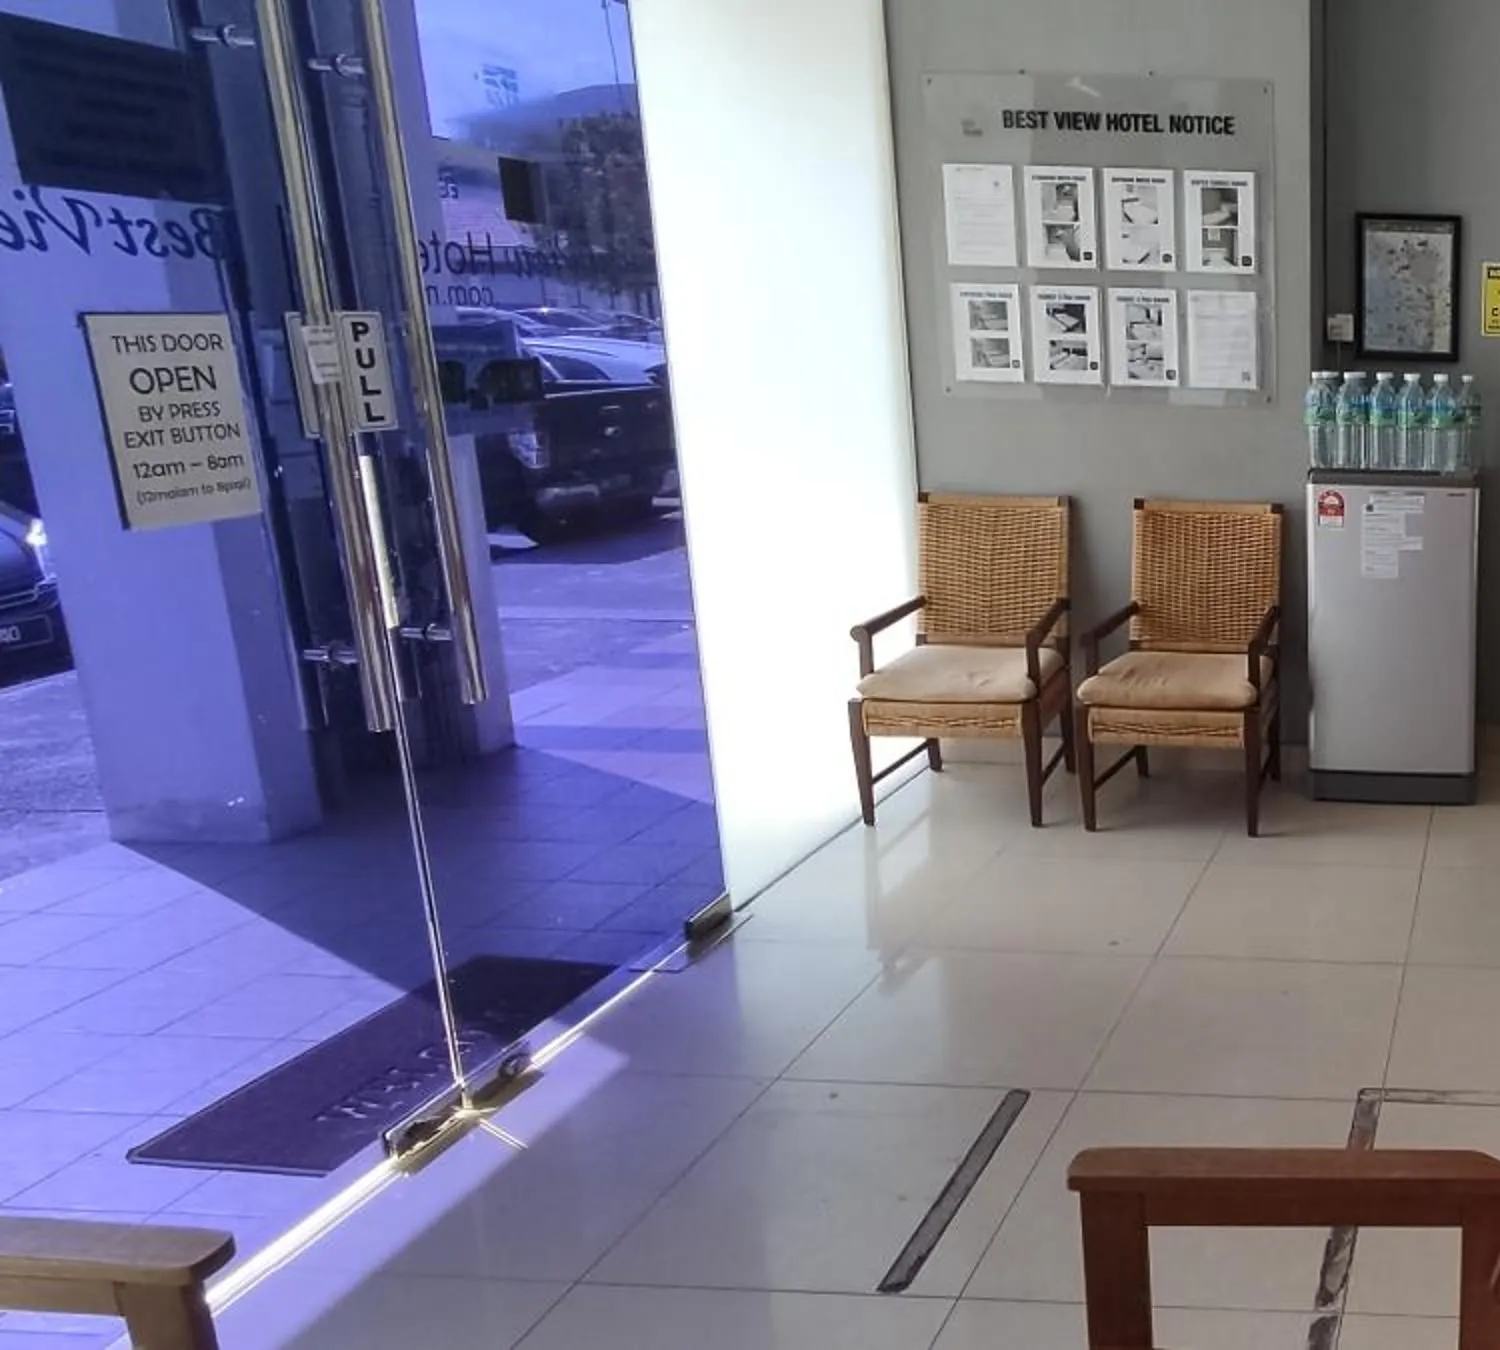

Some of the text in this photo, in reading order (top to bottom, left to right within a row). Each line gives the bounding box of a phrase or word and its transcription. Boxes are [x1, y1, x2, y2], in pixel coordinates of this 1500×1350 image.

[1002, 109, 1049, 131] BEST
[1054, 111, 1100, 132] VIEW
[1106, 112, 1163, 134] HOTEL
[1169, 115, 1236, 136] NOTICE
[111, 332, 224, 354] THIS DOOR
[129, 365, 217, 395] OPEN
[350, 321, 385, 422] PULL
[138, 400, 221, 423] BY PRESS
[123, 422, 241, 449] EXIT BUTTON
[132, 459, 185, 479] 12am
